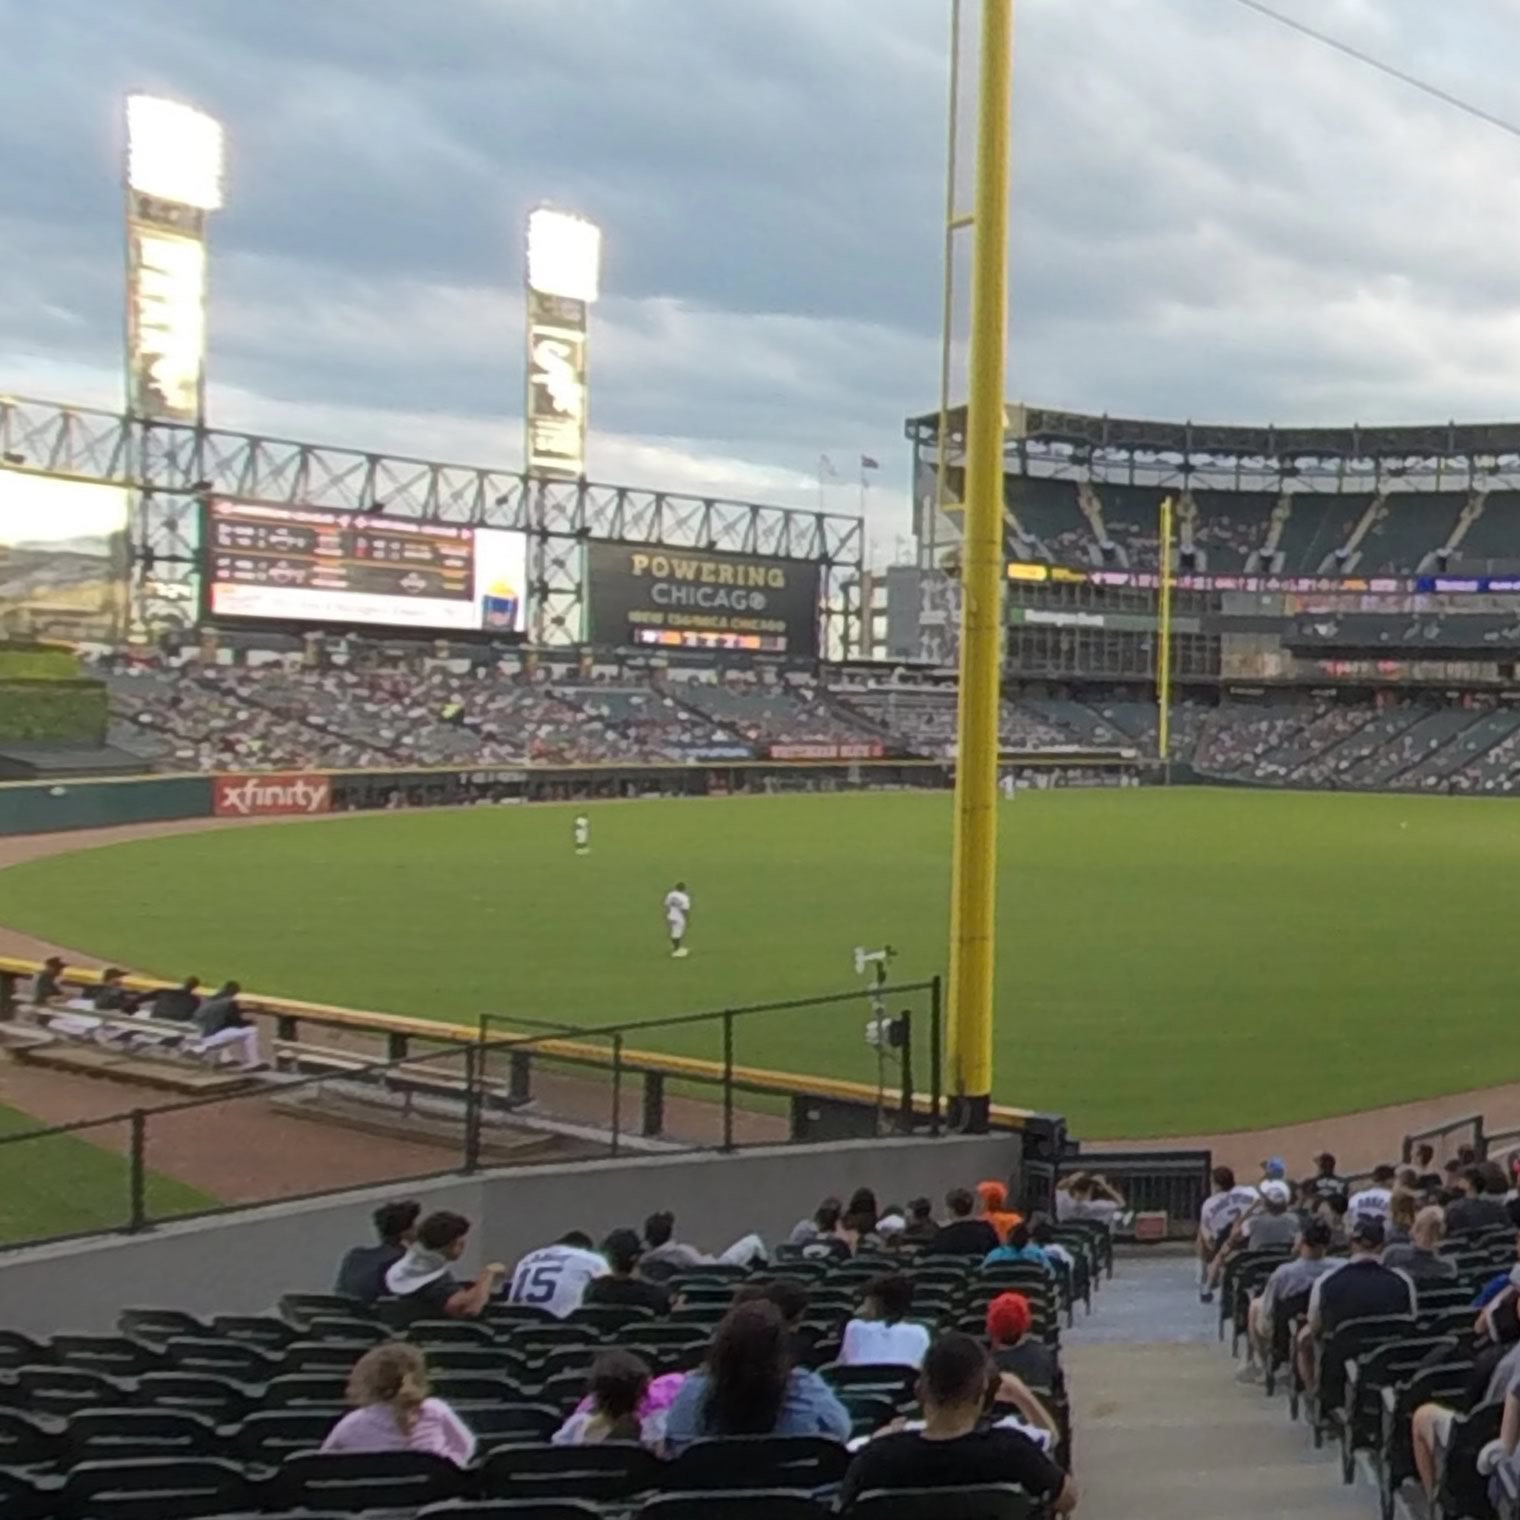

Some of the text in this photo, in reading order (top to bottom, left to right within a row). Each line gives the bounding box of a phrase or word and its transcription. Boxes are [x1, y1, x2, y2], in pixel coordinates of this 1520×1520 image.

[631, 554, 786, 588] POWERING
[651, 583, 767, 610] CHICAGO
[221, 778, 328, 814] xfinity
[512, 1266, 564, 1303] 15
